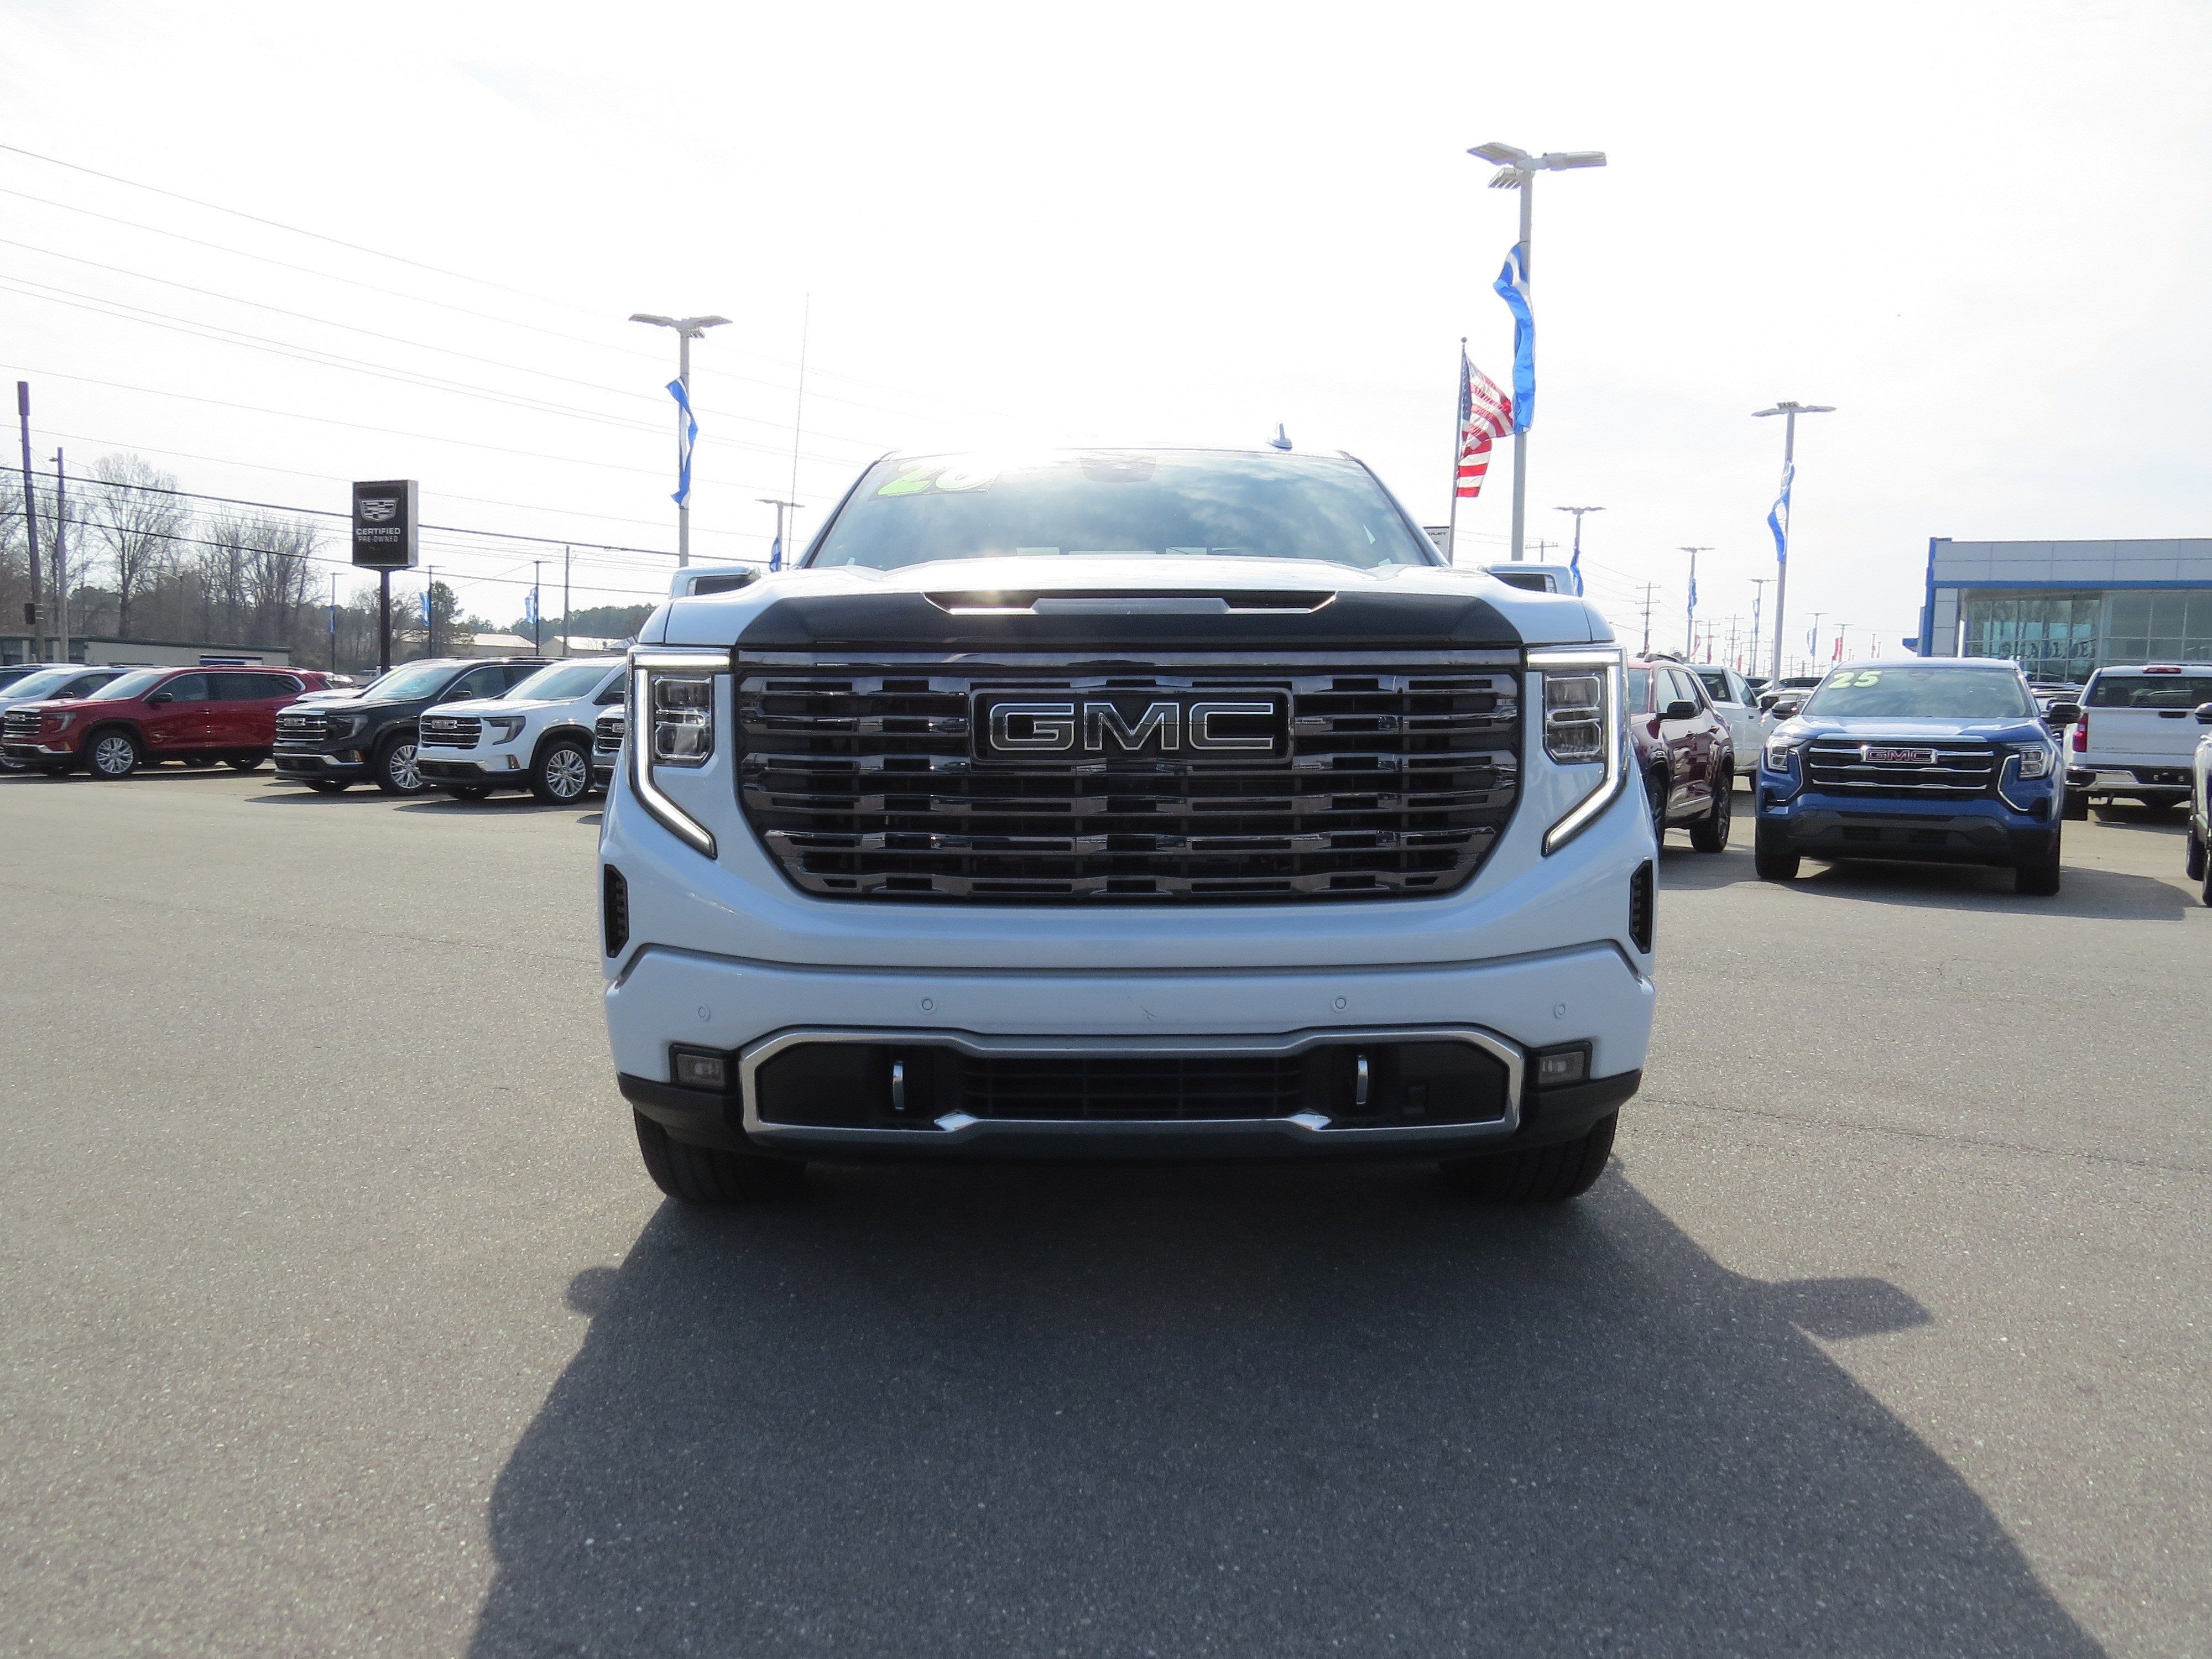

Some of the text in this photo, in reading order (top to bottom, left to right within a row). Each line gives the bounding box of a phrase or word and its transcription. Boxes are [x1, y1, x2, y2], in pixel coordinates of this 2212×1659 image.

[1828, 671, 1883, 689] 25
[989, 702, 1274, 751] GMC
[1866, 749, 1932, 761] GMC
